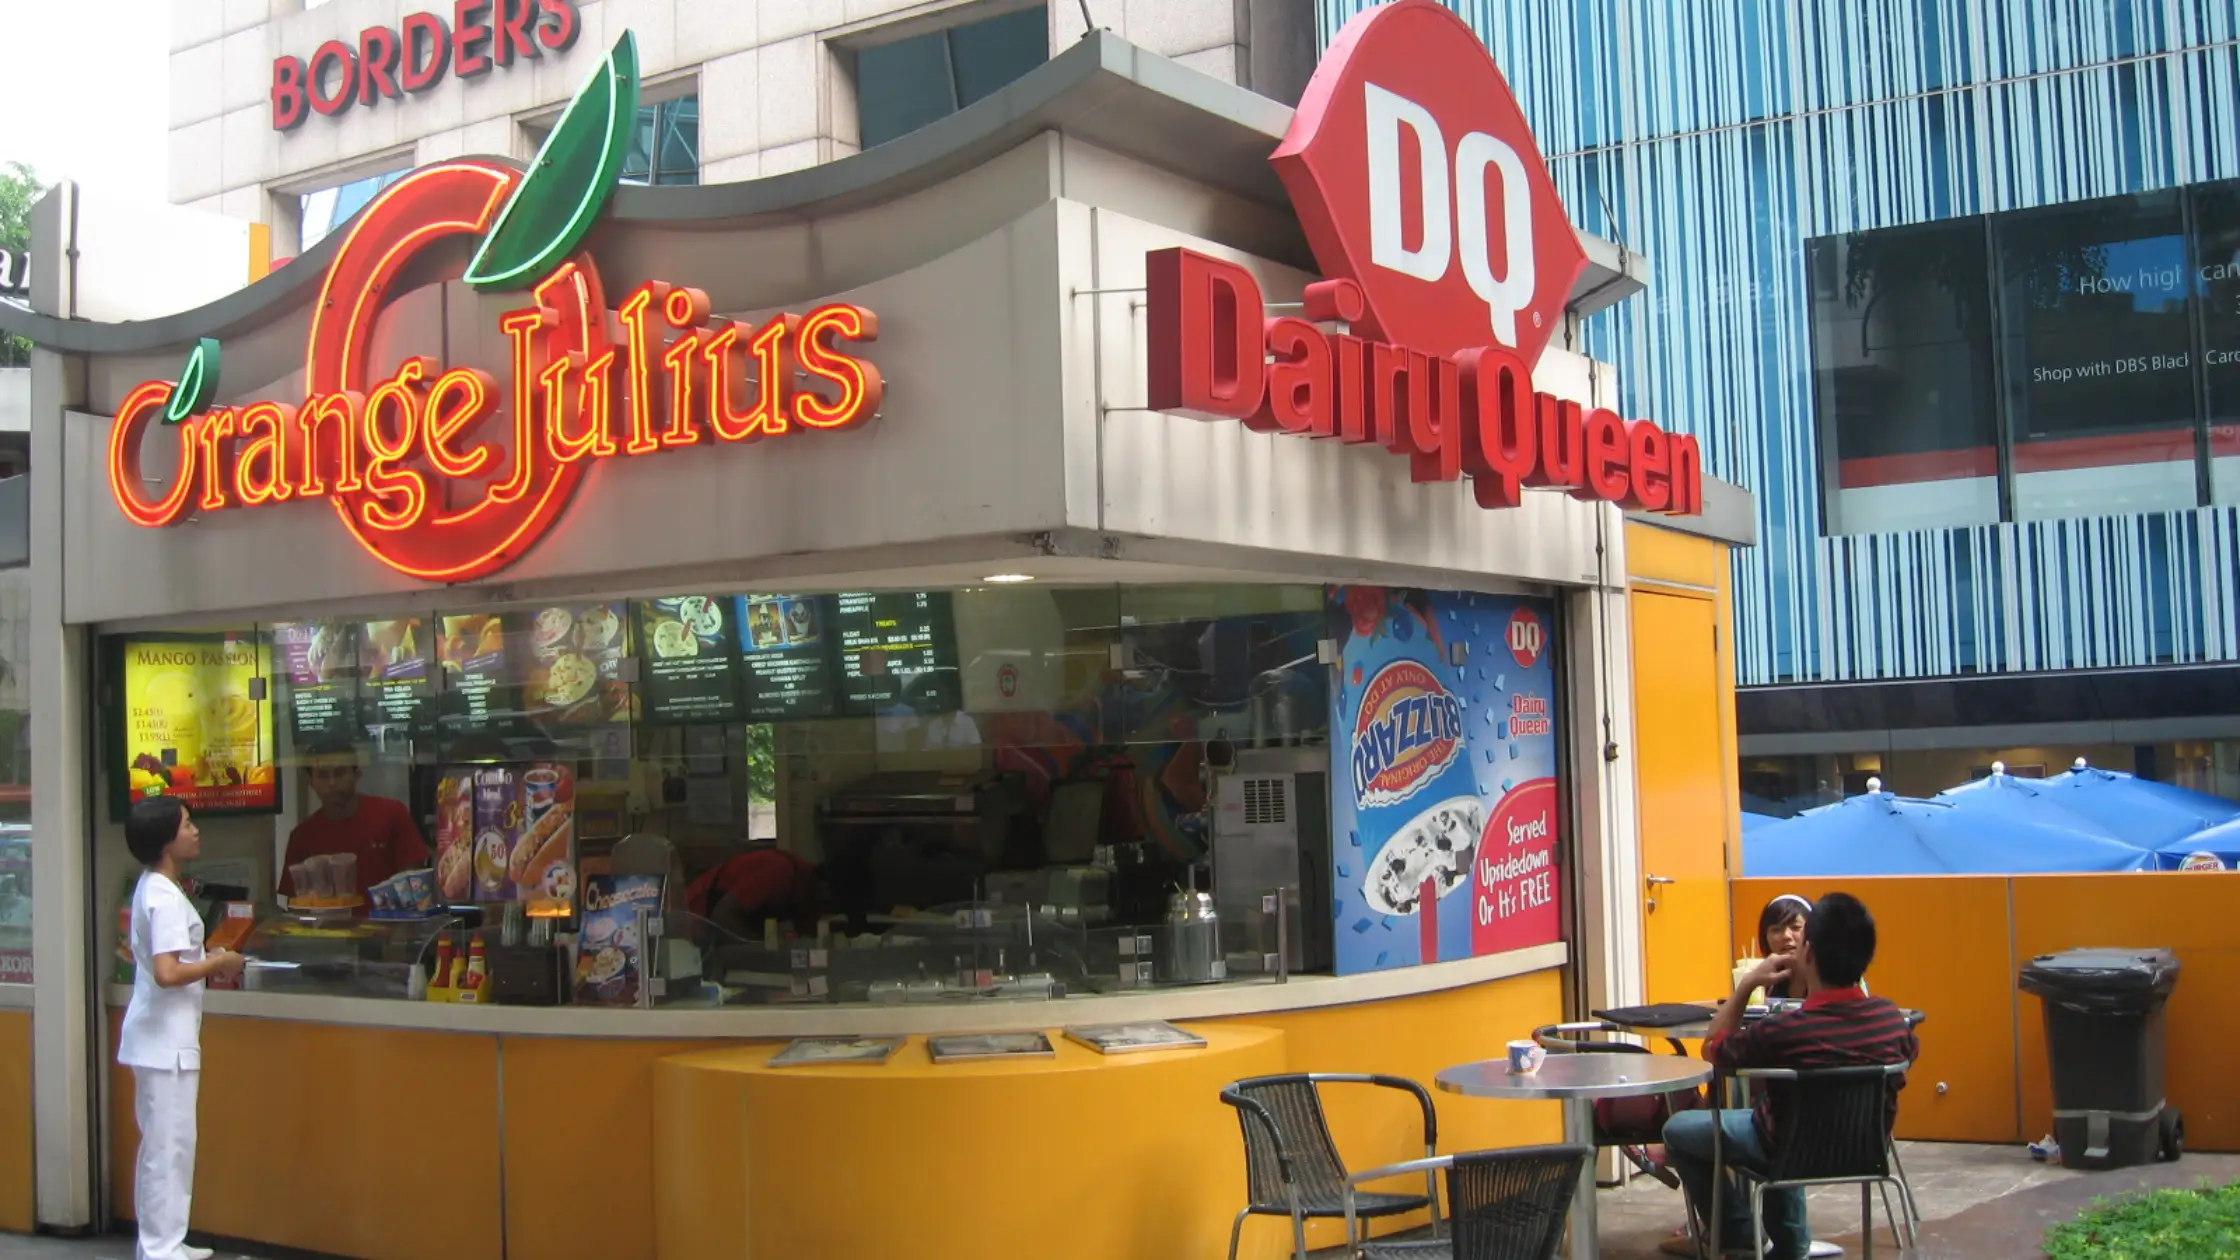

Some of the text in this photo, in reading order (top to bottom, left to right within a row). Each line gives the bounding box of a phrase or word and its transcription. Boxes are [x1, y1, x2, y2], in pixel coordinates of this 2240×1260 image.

[271, 0, 581, 131] BORDERS
[1364, 80, 1536, 348] DQ
[2080, 274, 2132, 295] How
[1146, 247, 1704, 517] Dairy Queen
[2033, 366, 2073, 383] Shop
[2076, 360, 2111, 377] with
[2115, 356, 2148, 374] DBS
[487, 280, 882, 506] Julius
[108, 356, 502, 532] Orange
[136, 649, 258, 667] MANGO PASSION
[1511, 620, 1541, 658] DQ
[1513, 691, 1546, 717] Dairy
[1352, 693, 1462, 802] BLIZZARD
[1509, 715, 1550, 738] Queen
[1379, 756, 1428, 787] ORIGINAL
[1507, 809, 1547, 847] Served
[1480, 847, 1550, 894] Upsidedown
[1478, 871, 1551, 926] Or It's FREE
